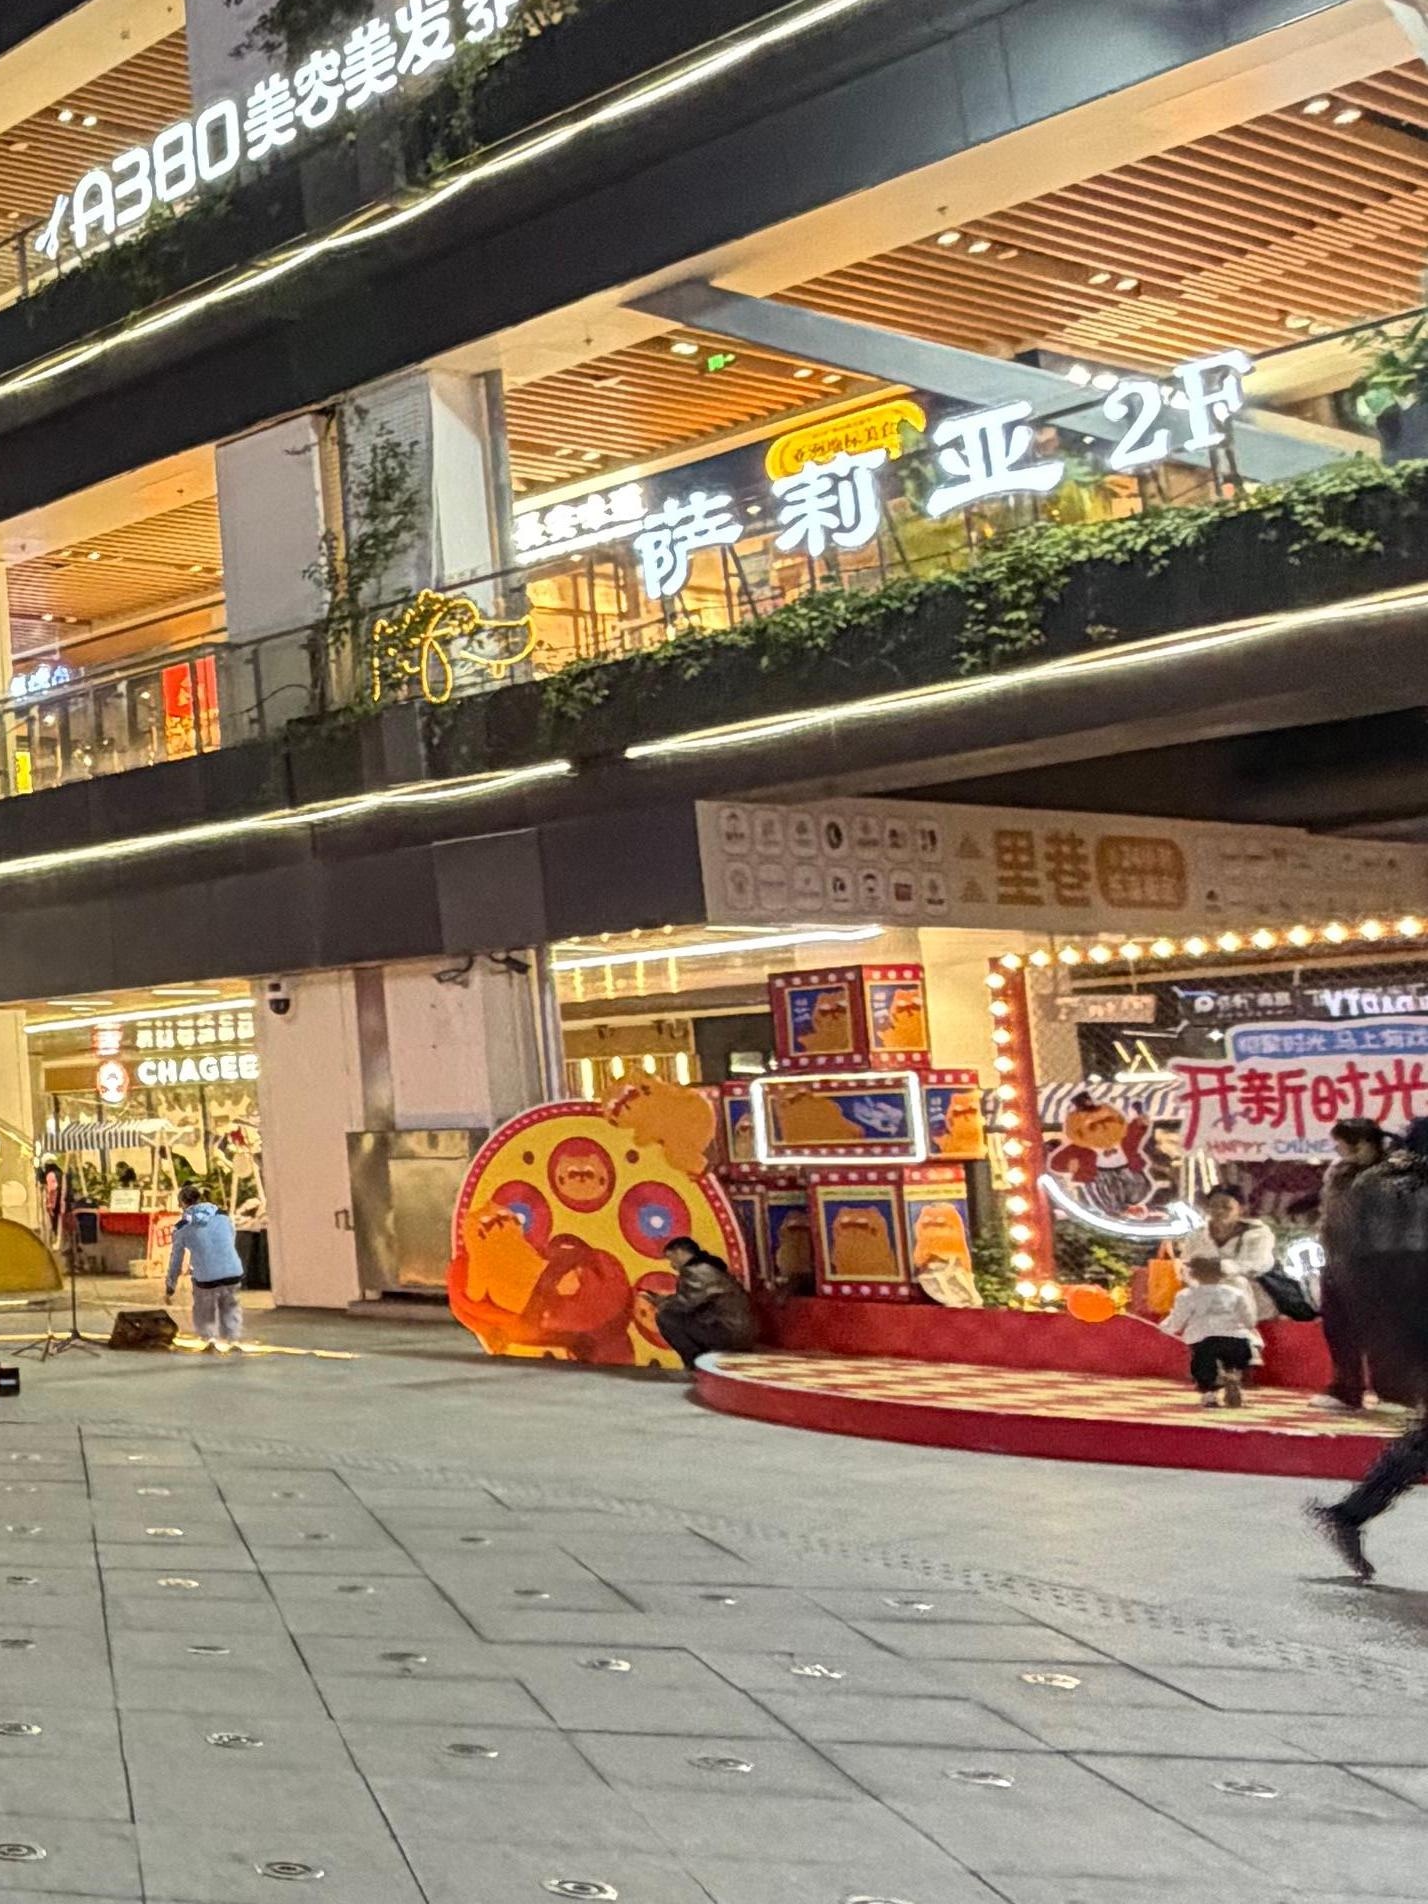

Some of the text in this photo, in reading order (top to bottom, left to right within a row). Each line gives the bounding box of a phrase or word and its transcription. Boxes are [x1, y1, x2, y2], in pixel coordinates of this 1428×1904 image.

[632, 400, 1065, 599] 萨莉亚
[1104, 350, 1256, 473] 2F
[137, 1053, 261, 1085] CHAGEE
[1173, 1059, 1428, 1150] 开新时光
